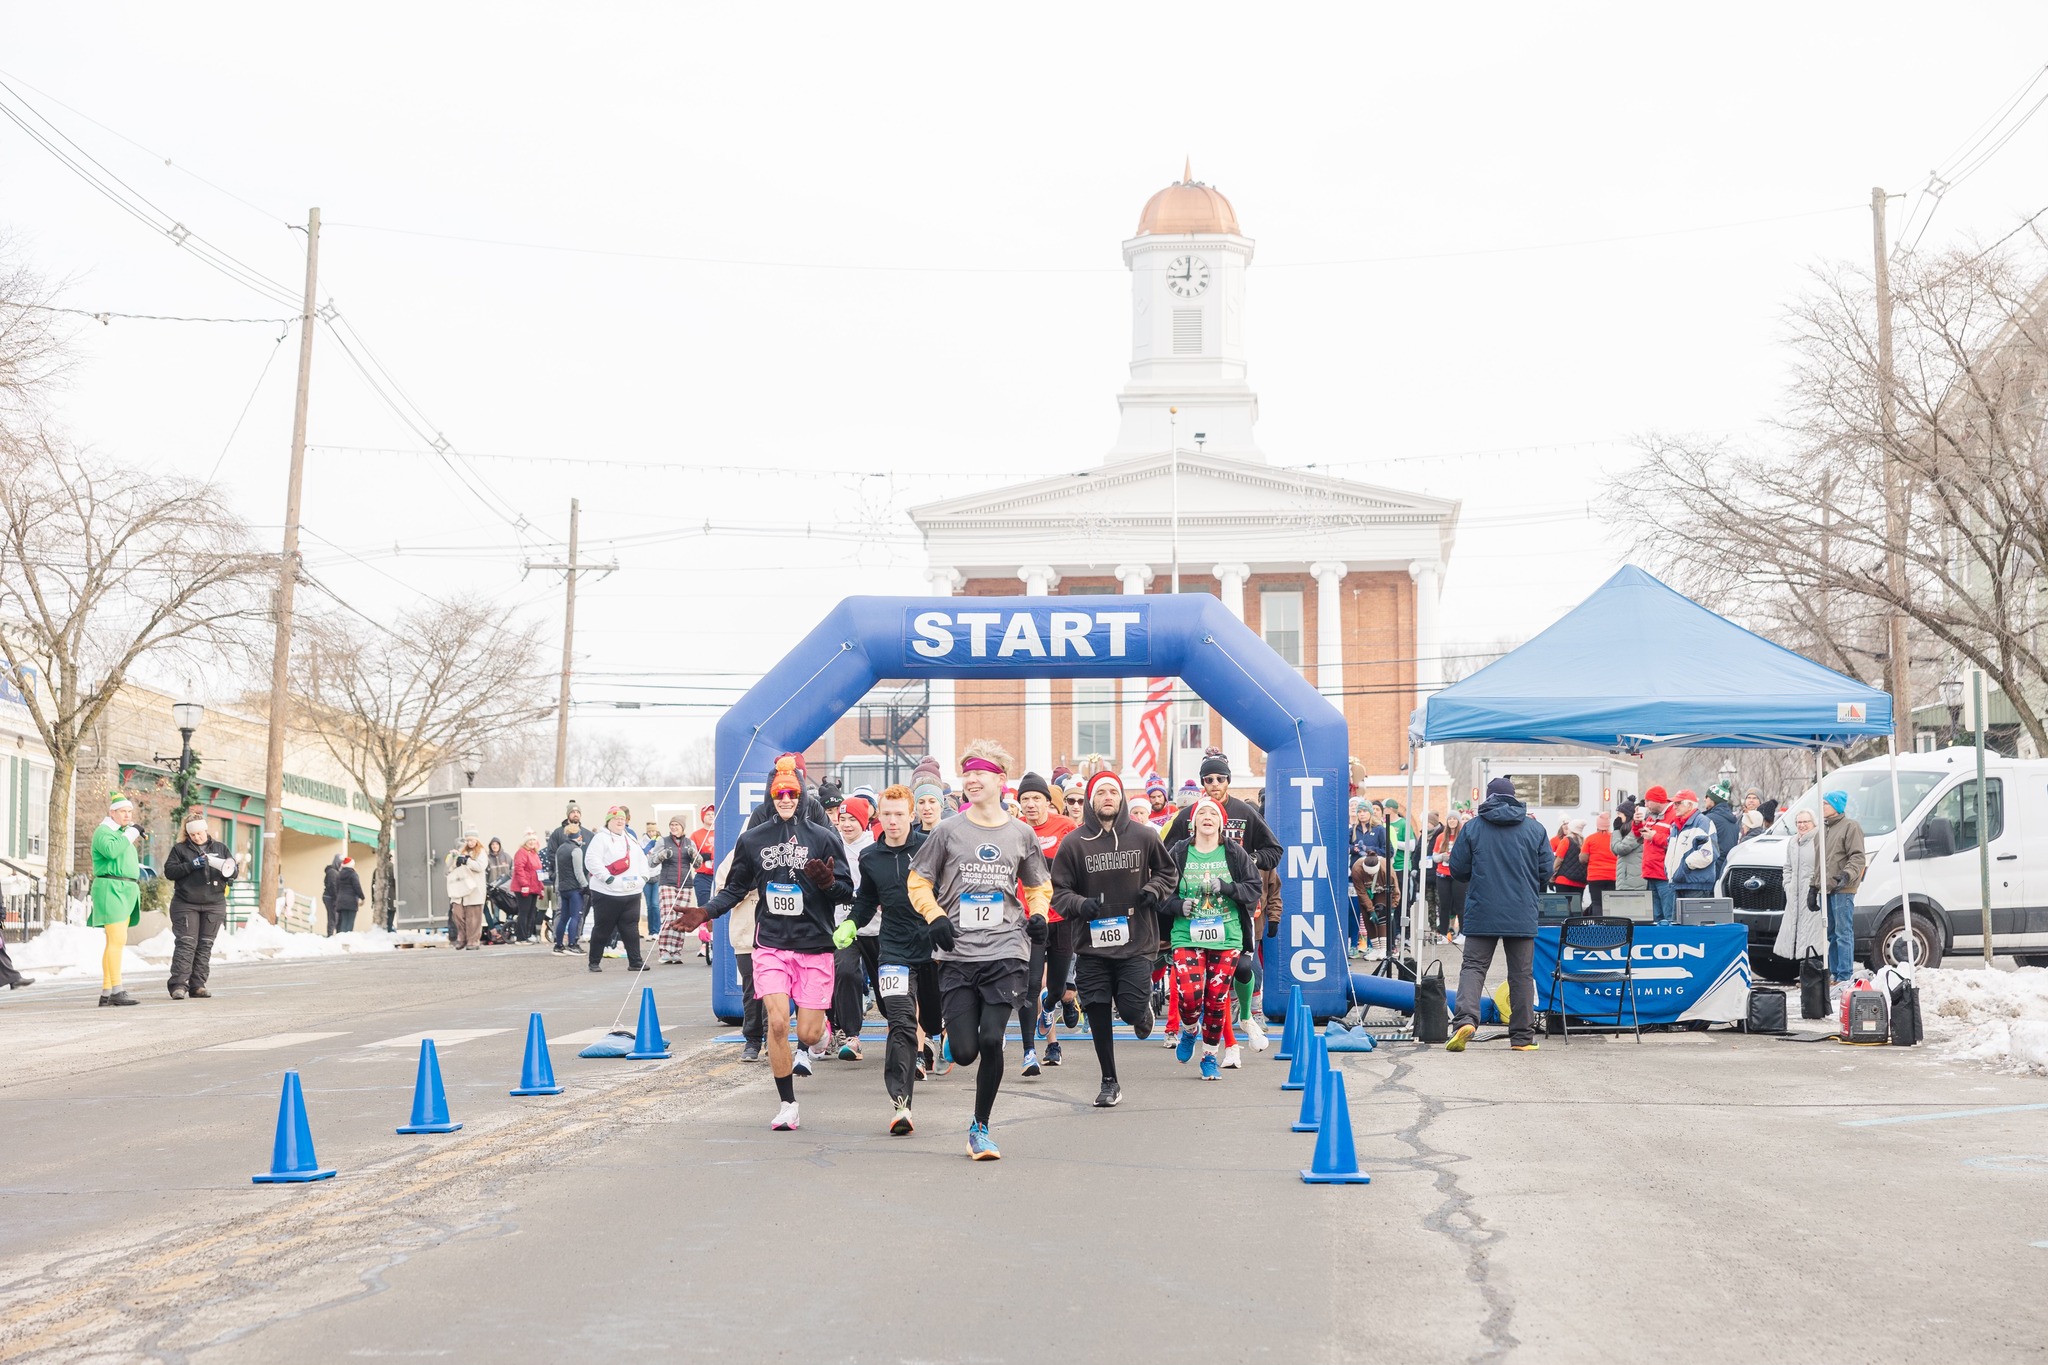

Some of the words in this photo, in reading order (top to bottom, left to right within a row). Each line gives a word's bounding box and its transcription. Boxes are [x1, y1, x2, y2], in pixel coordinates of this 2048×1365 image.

[911, 611, 1141, 658] START
[282, 771, 347, 808] SUSQUEHANNA
[760, 842, 795, 859] CROSS
[761, 855, 809, 871] COUNTRY
[1085, 849, 1141, 873] CARHARTT
[959, 863, 1014, 875] SCRANTON
[961, 871, 982, 879] CROSS
[982, 873, 1009, 881] COUNTRY
[1287, 777, 1327, 982] TIMING
[773, 896, 795, 911] 698
[975, 906, 990, 921] 12
[1099, 928, 1121, 943] 468
[1198, 928, 1218, 941] 700
[1563, 943, 1705, 961] FALCON
[880, 976, 900, 991] 202
[1584, 987, 1621, 996] RACE
[1627, 986, 1684, 996] TIMING
